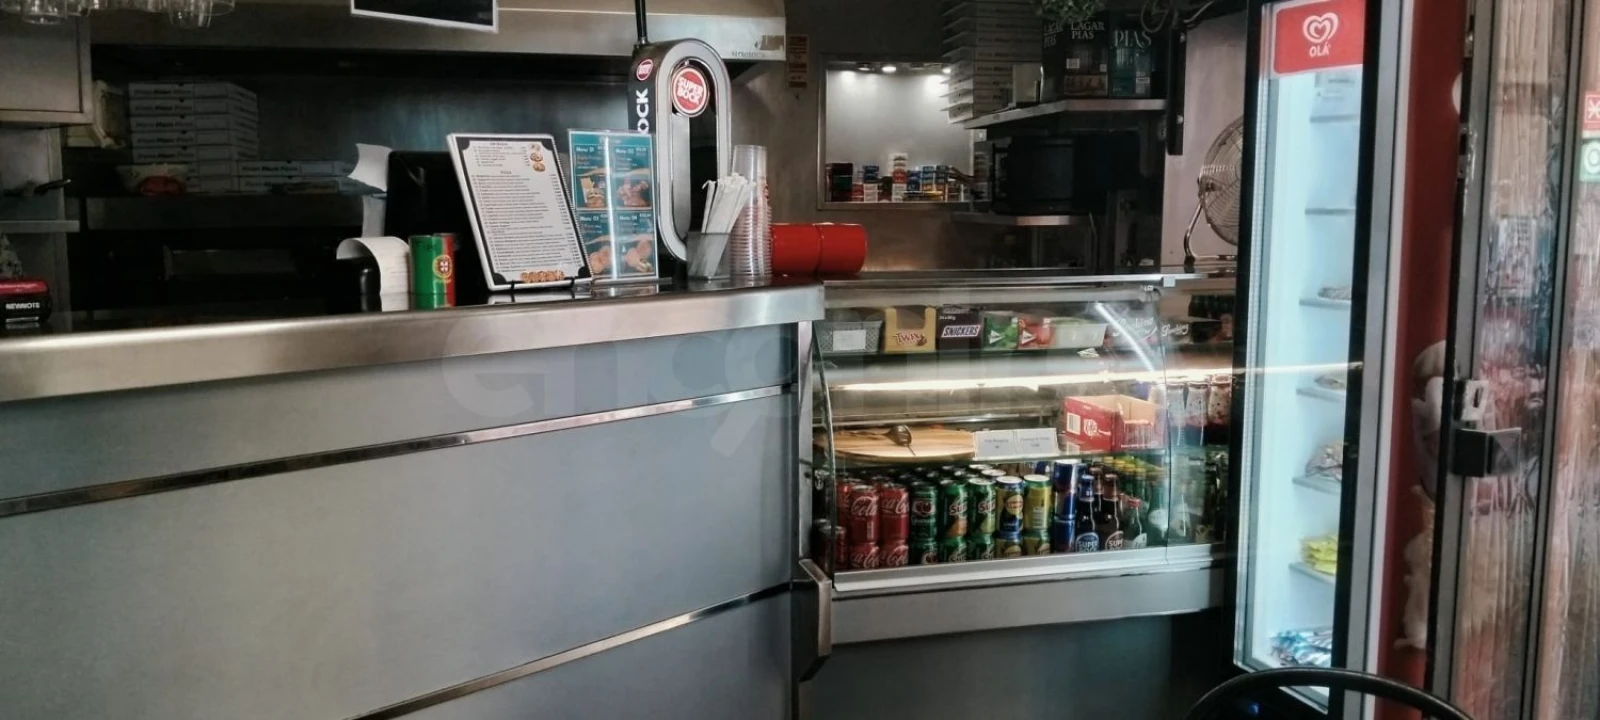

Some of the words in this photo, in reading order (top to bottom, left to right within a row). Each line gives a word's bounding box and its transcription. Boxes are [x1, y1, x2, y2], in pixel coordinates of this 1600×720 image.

[1070, 21, 1105, 31] LAGAR
[1072, 31, 1095, 40] PIAS
[1113, 29, 1152, 49] PIAS
[1308, 41, 1330, 58] OLÁ
[677, 76, 703, 93] SUPER
[676, 86, 701, 106] BOCK
[636, 88, 649, 134] OCK
[943, 325, 979, 337] SNICKERS
